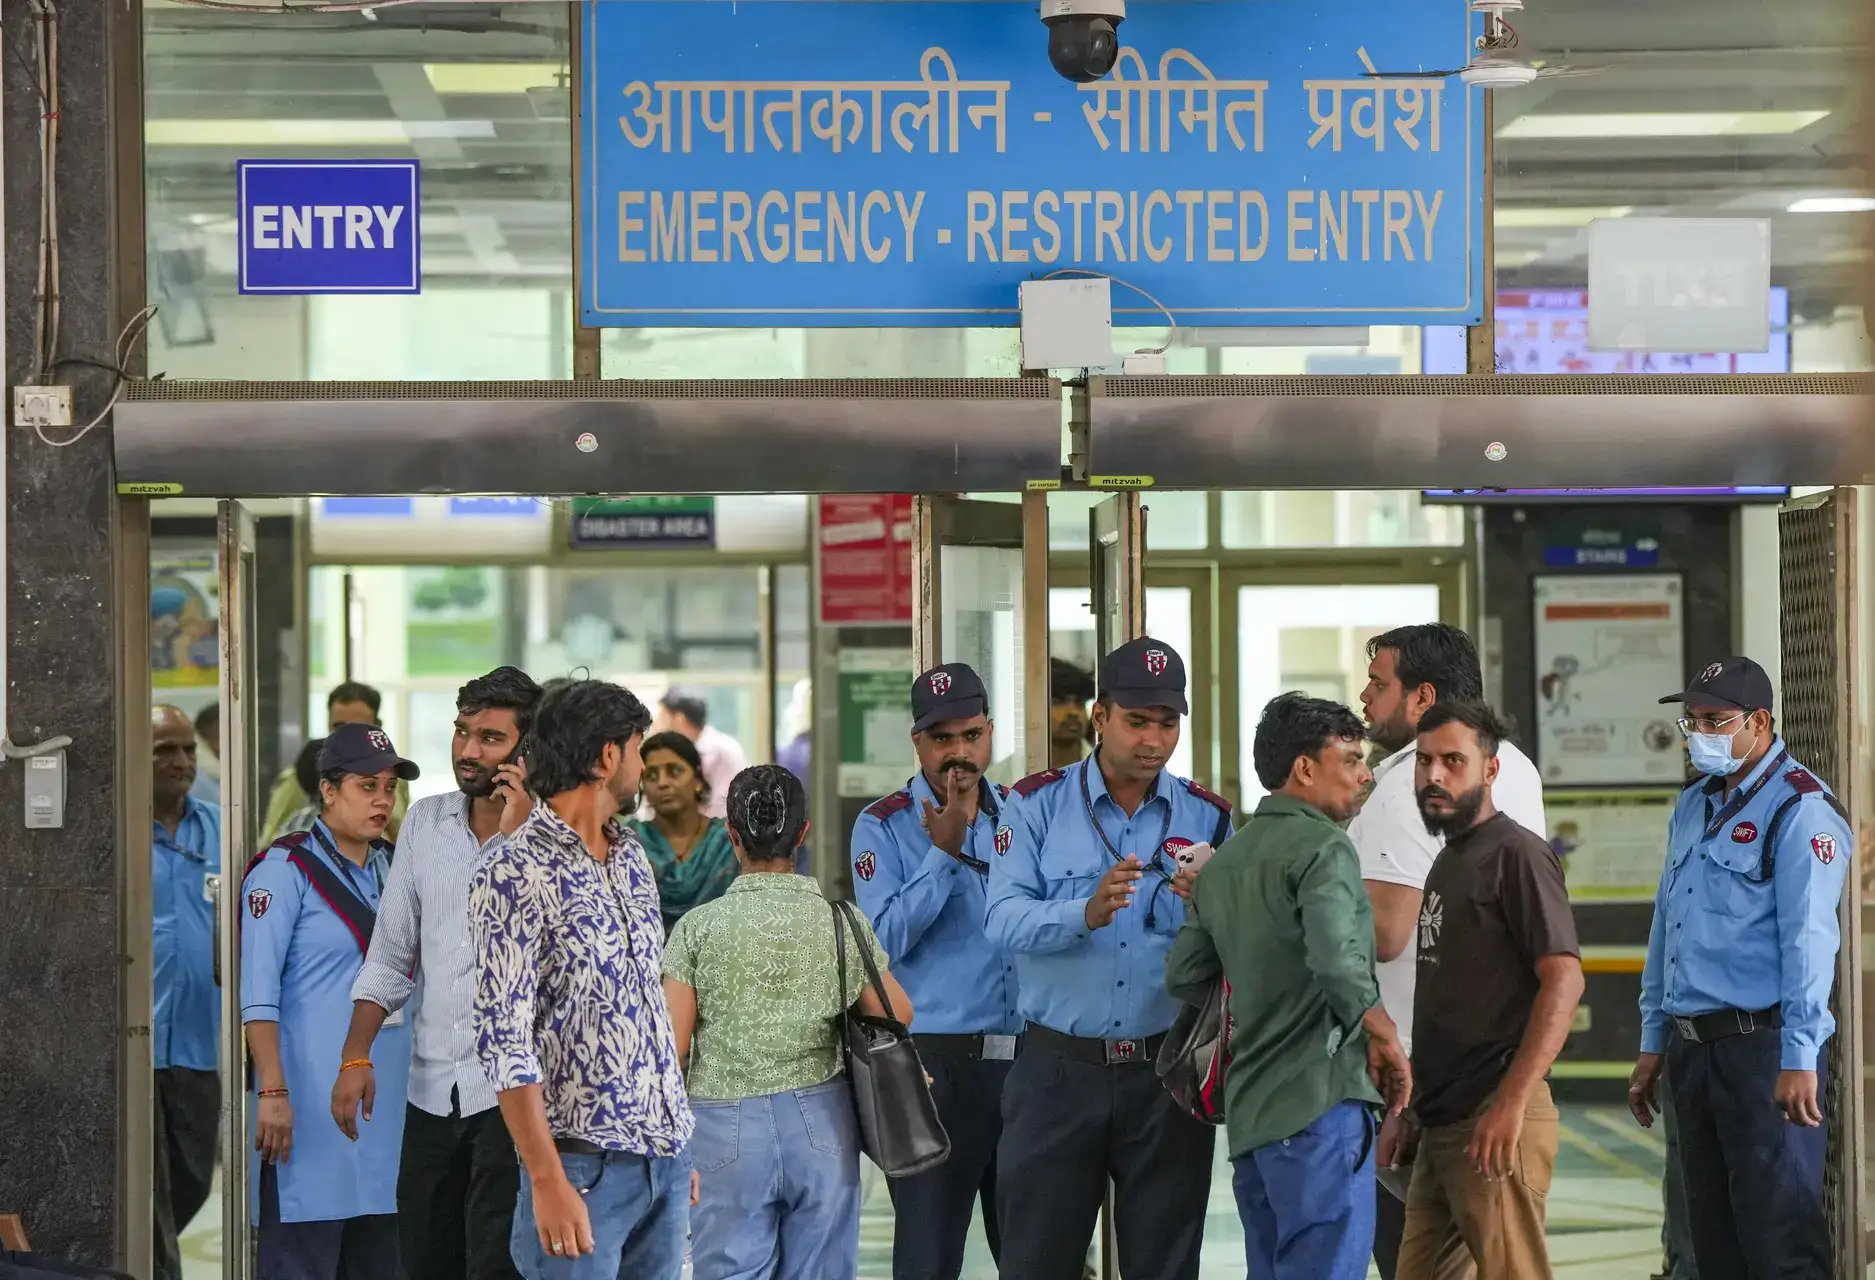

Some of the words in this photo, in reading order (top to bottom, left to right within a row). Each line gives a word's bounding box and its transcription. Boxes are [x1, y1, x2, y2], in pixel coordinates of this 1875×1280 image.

[618, 46, 1011, 153] आपातकालीन
[1077, 46, 1269, 153] सीमित
[1303, 46, 1445, 152] प्रवेश
[253, 205, 404, 249] ENTRY
[618, 190, 926, 263] EMERGENCY
[967, 190, 1269, 263] RESTRICTED
[1287, 190, 1445, 262] ENTRY
[130, 485, 171, 493] mitzvah
[1102, 478, 1142, 486] mitzvah
[580, 516, 660, 539] DISASTER
[663, 516, 709, 538] AREA
[1733, 826, 1756, 840] SWIFT
